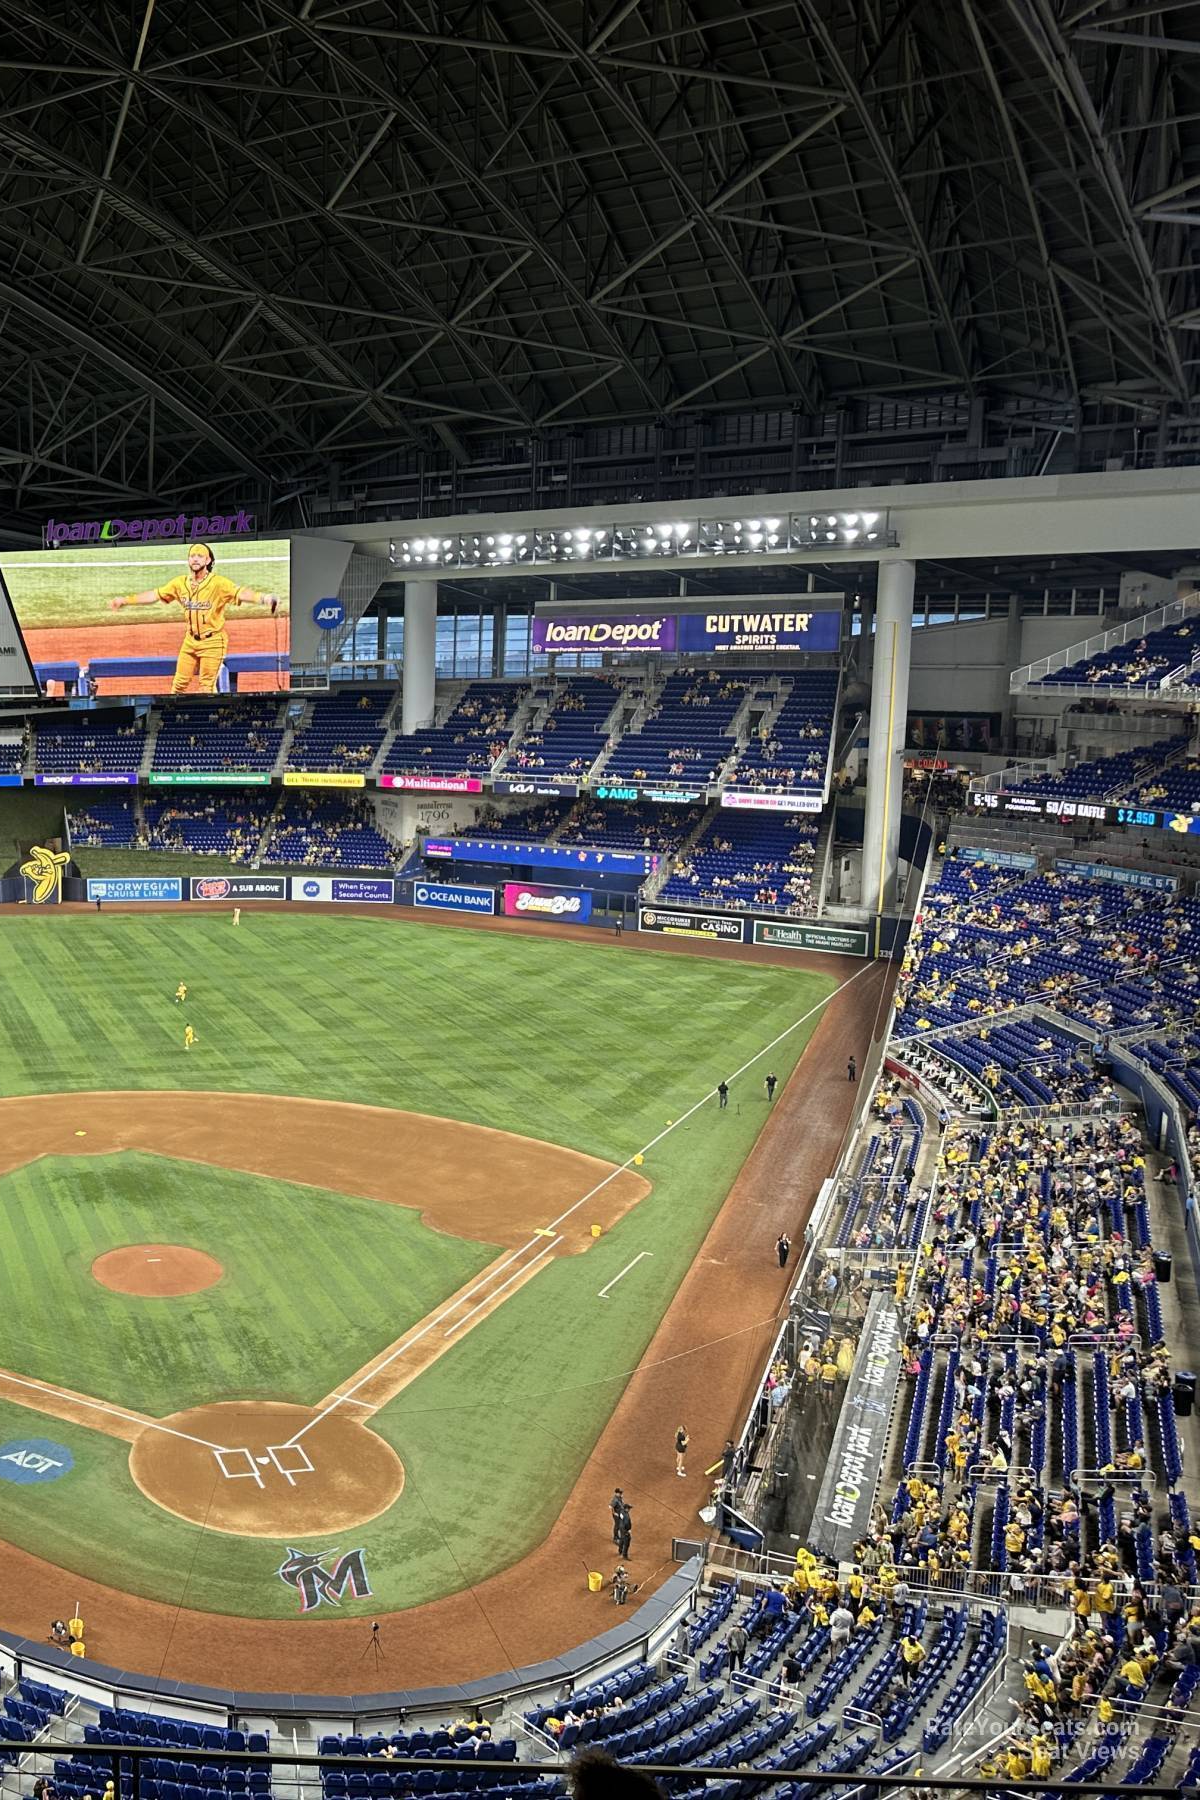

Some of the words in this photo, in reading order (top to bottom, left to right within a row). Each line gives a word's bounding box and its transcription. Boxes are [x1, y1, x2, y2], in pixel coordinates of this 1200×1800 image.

[47, 514, 187, 542] loanDepot
[191, 510, 251, 539] park
[317, 607, 342, 620] ADT
[706, 613, 809, 633] CUTWATER
[545, 618, 661, 645] loanDepot
[735, 634, 777, 645] SPIRITS
[405, 778, 468, 791] Multinational
[509, 784, 534, 793] KIA
[609, 787, 638, 800] AMG
[974, 793, 999, 808] 5:45
[1005, 804, 1041, 813] FOUNDATION
[1046, 801, 1075, 816] 50/50
[1076, 803, 1106, 819] RAFFLE
[419, 810, 450, 825] 1796
[1126, 810, 1155, 825] 2,950
[1092, 868, 1113, 879] LEARN
[1113, 870, 1130, 882] MORE
[1130, 874, 1139, 883] AT
[1156, 879, 1163, 888] 15
[107, 882, 178, 891] NORWEGIAN
[107, 890, 142, 898] CRUISE
[239, 884, 254, 892] SUB
[255, 884, 280, 892] ABOVE
[305, 886, 320, 894] ADT
[338, 883, 358, 891] When
[359, 884, 378, 892] Every
[429, 892, 463, 905] OCEAN
[463, 894, 491, 907] BANK
[700, 922, 739, 934] CASINO
[874, 1309, 900, 1335] park
[859, 1329, 896, 1387] loanDepot
[846, 1424, 874, 1458] park
[0, 1450, 63, 1474] ADT
[824, 1451, 869, 1529] loanDepot
